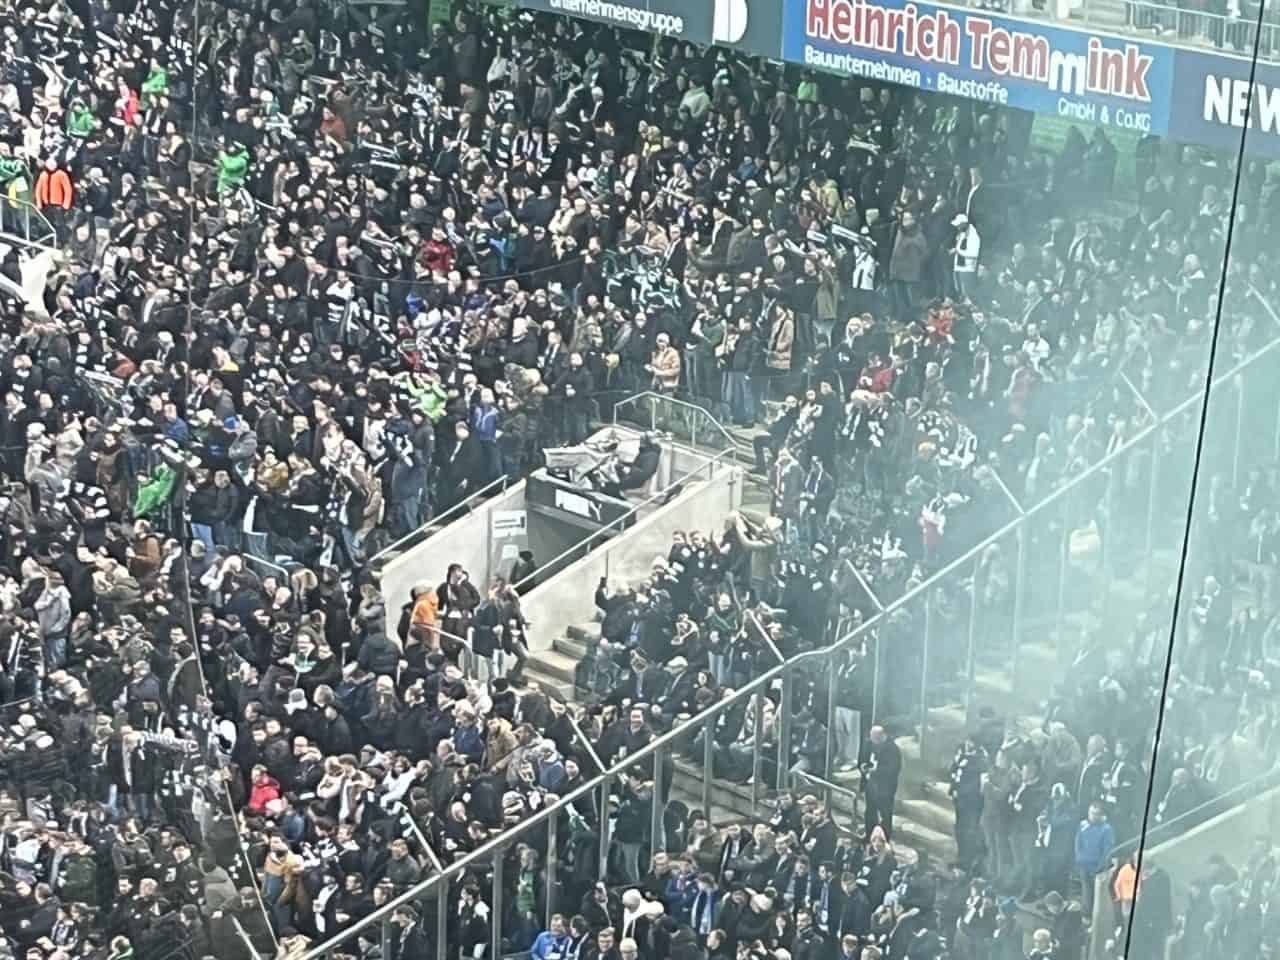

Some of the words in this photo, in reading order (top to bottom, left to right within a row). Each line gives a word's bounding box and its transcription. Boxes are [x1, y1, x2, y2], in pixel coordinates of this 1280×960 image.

[804, 45, 921, 88] Bauunternehmen
[936, 72, 1009, 105] Baustoffe
[805, 0, 961, 65] Heinrich
[966, 17, 1153, 102] Temmink
[1057, 97, 1096, 121] GmbH
[1100, 105, 1110, 124] &
